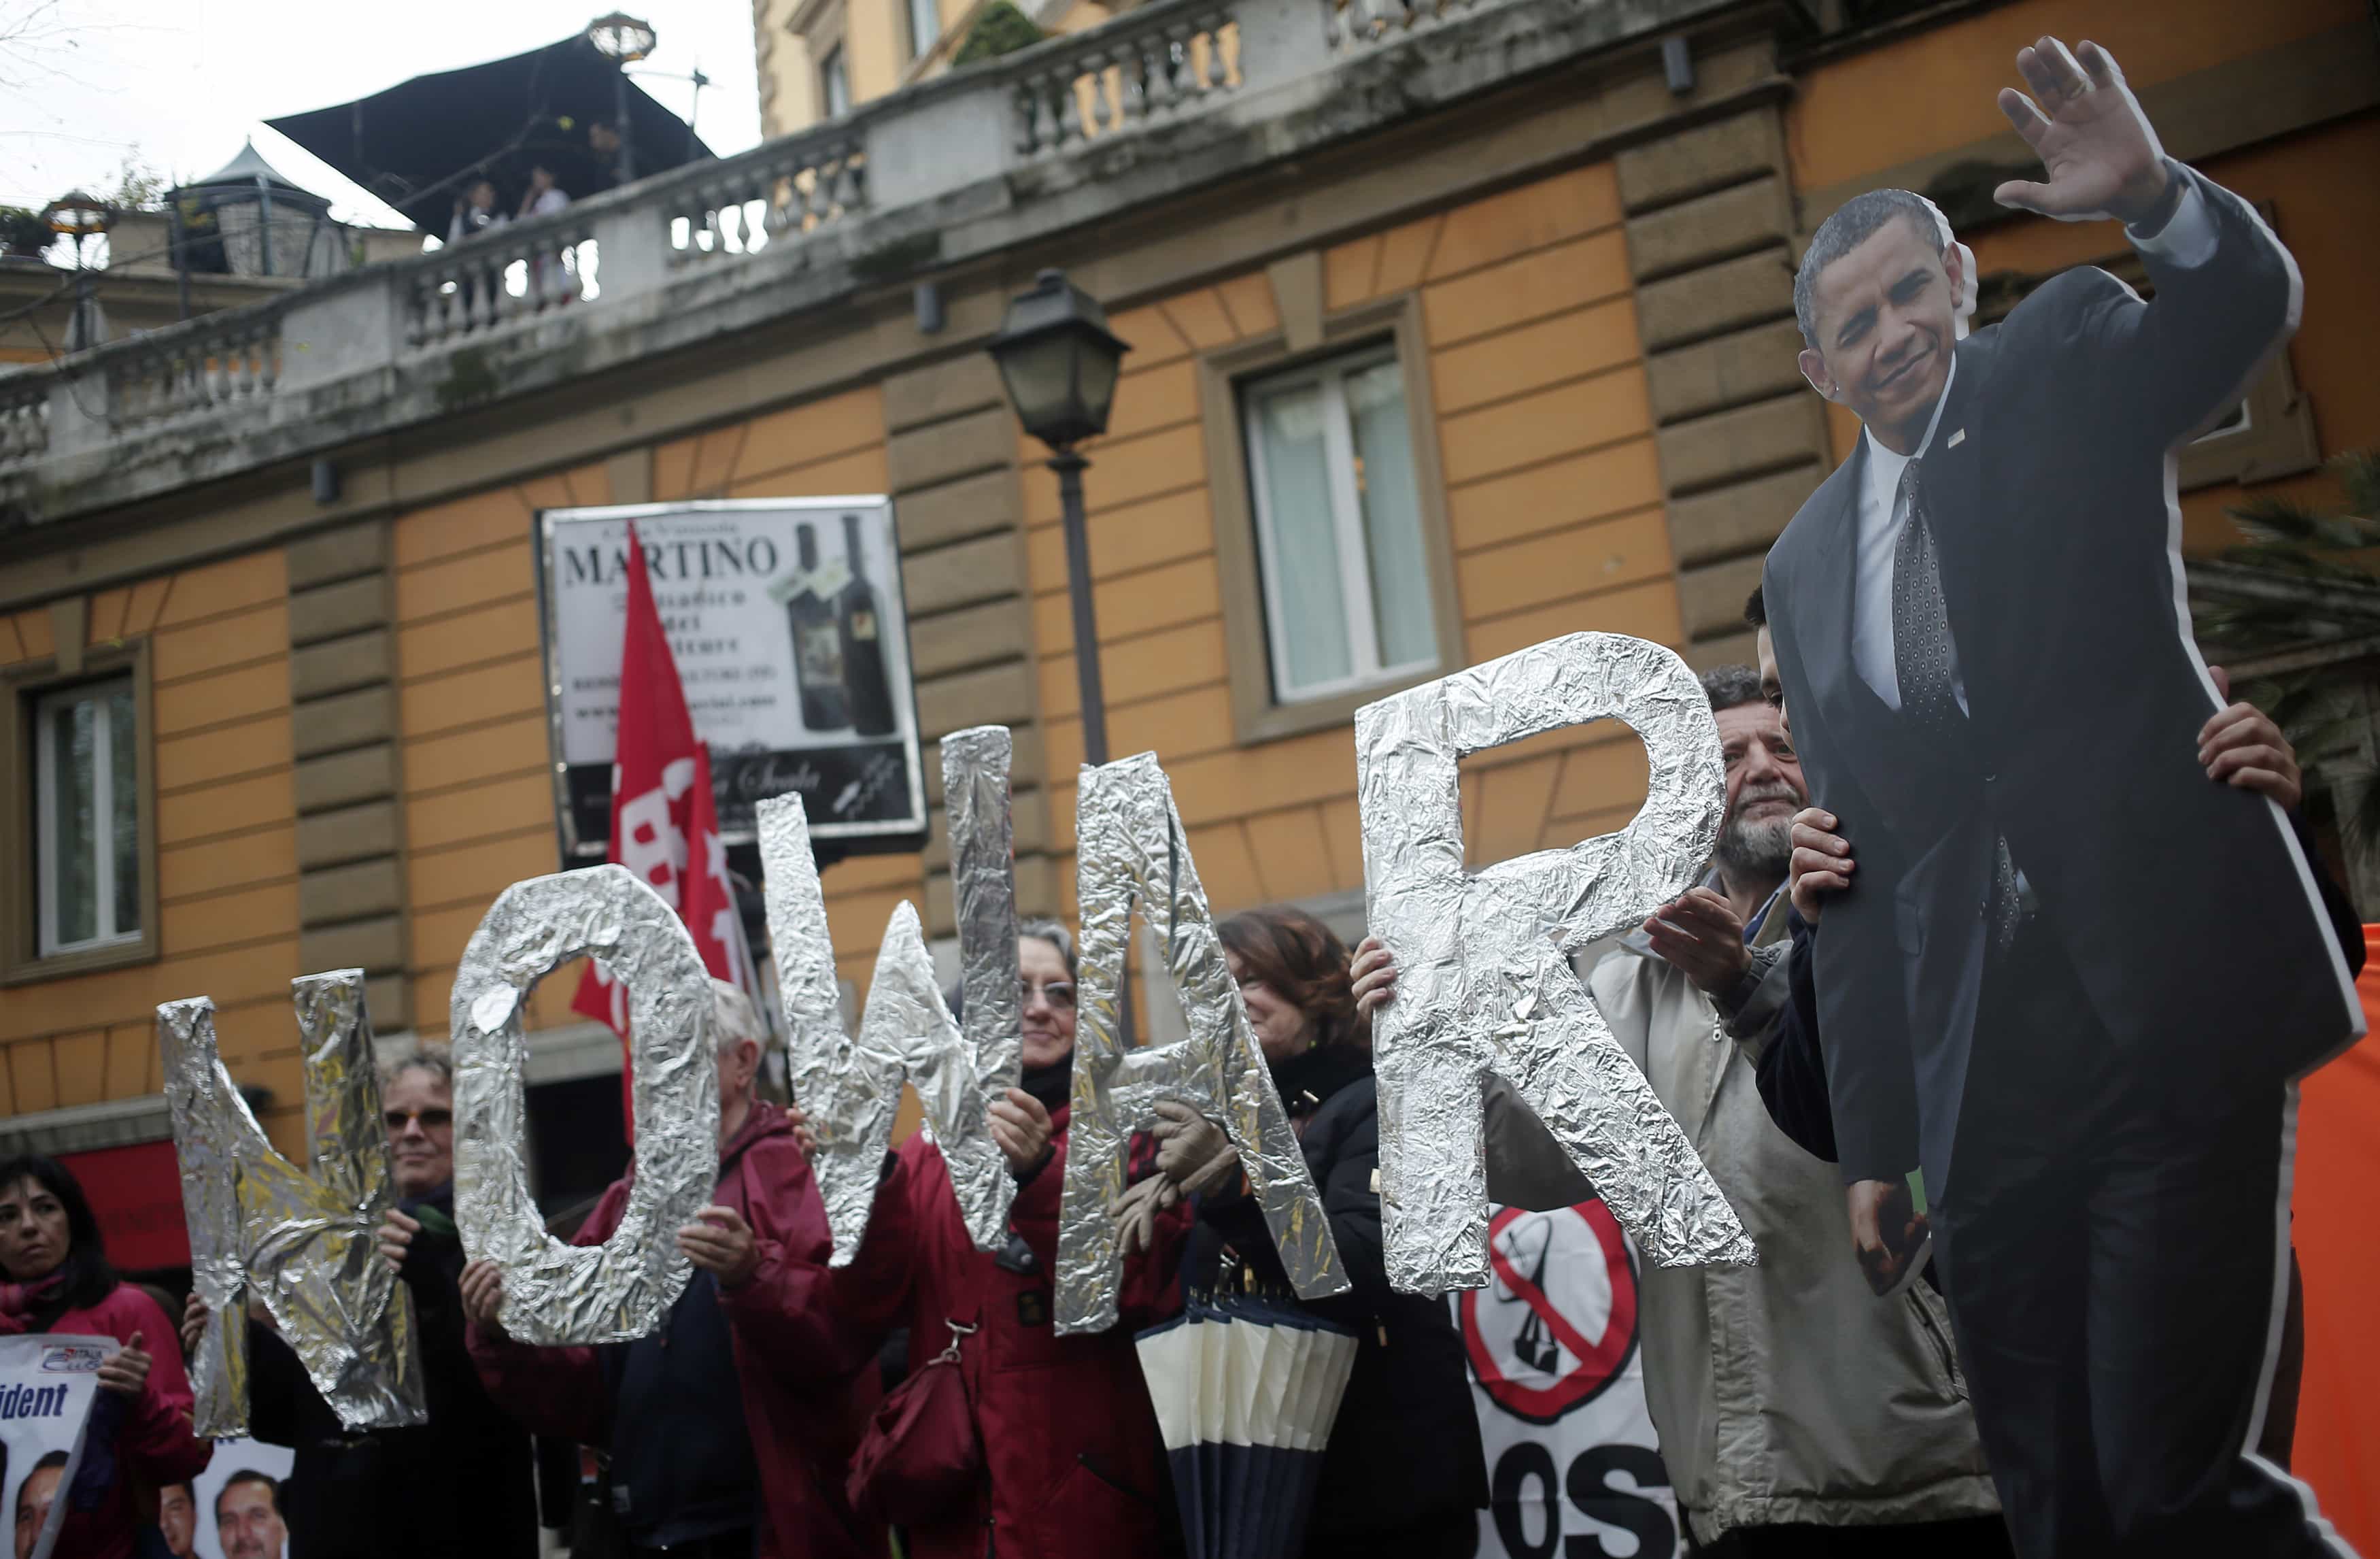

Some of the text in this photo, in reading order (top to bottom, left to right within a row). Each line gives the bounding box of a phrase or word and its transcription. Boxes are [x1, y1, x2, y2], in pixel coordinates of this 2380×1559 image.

[564, 535, 778, 587] MARTINO
[156, 631, 1760, 1440] NO WAR
